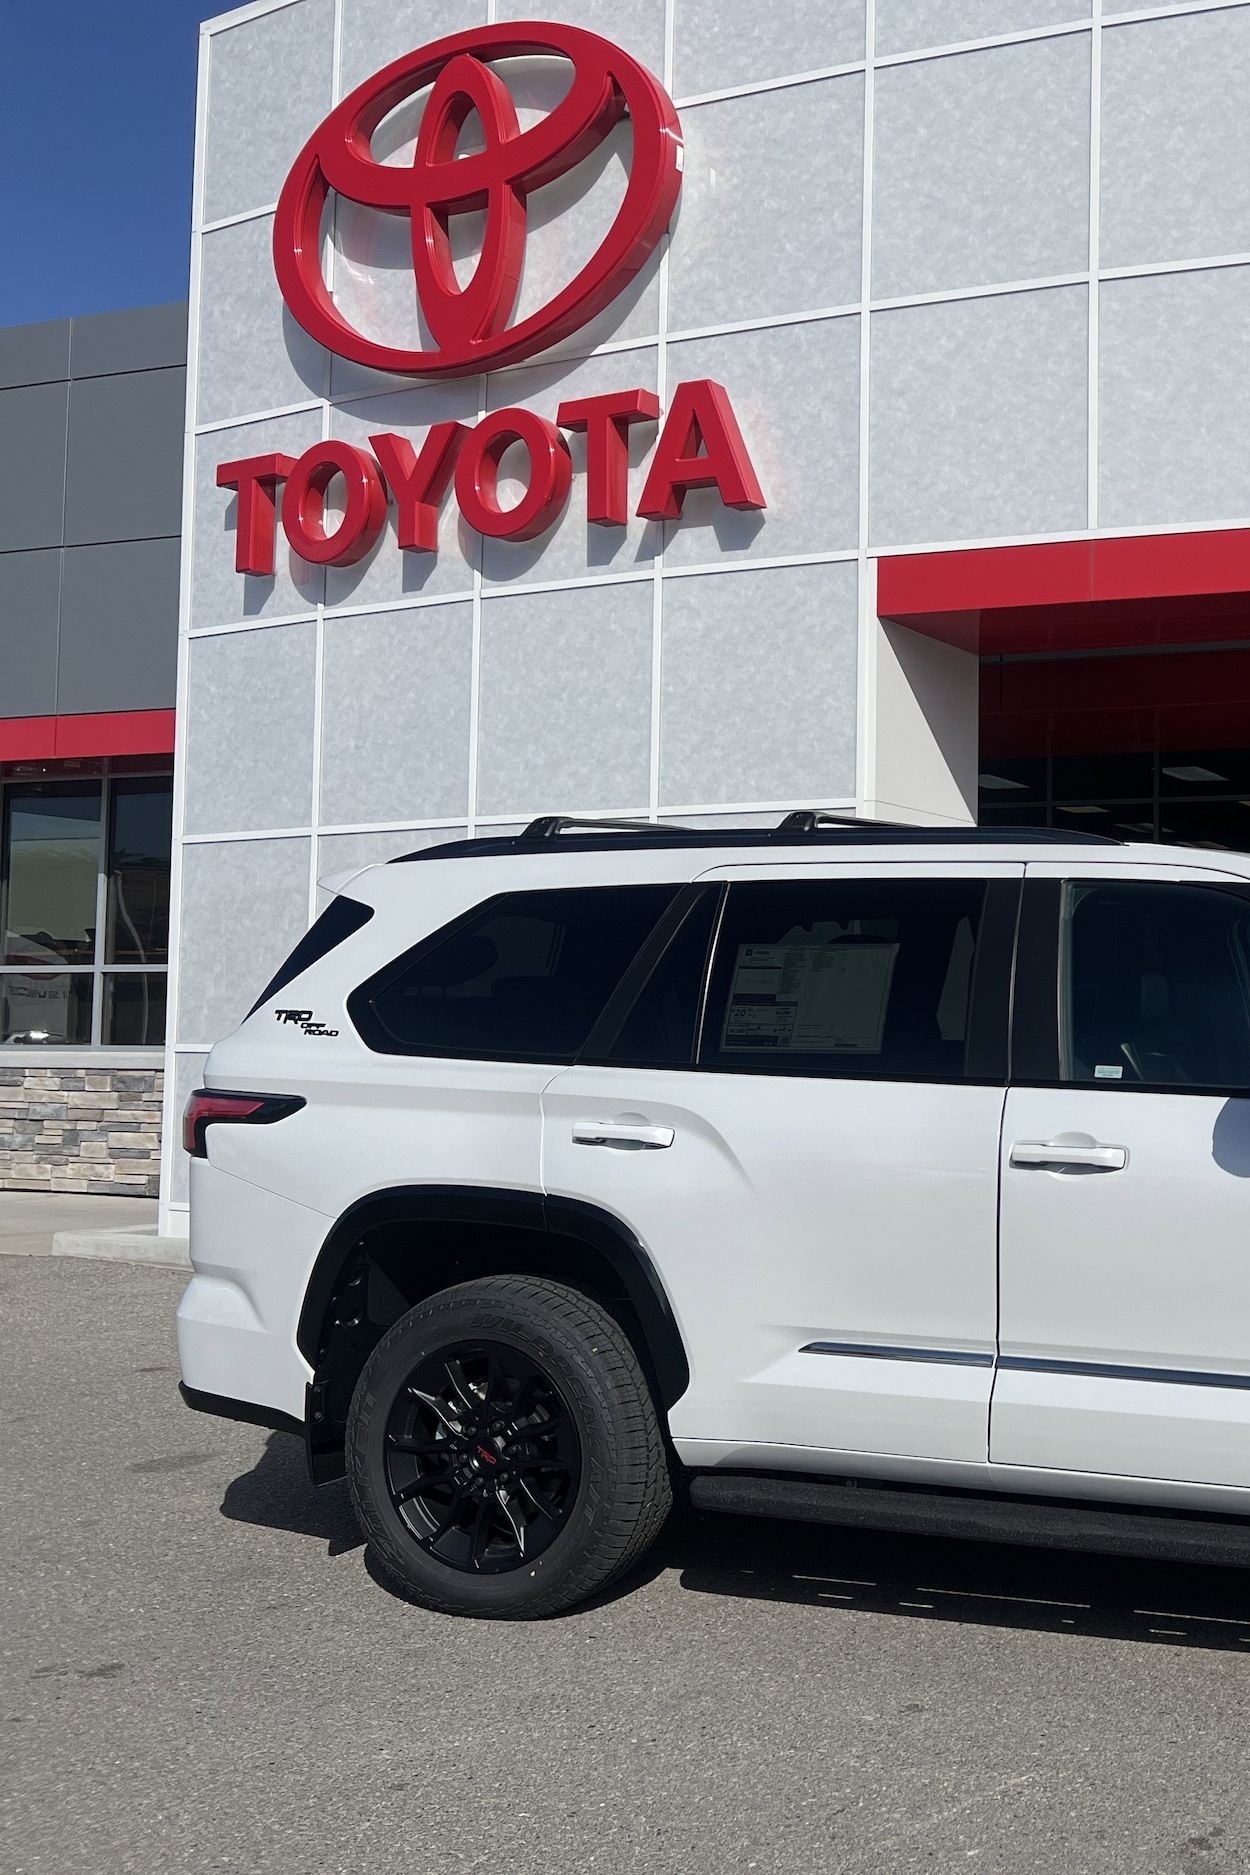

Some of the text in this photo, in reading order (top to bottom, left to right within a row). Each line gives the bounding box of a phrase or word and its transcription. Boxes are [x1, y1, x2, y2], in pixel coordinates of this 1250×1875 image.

[216, 379, 767, 577] TOYOTA
[275, 1009, 313, 1024] TRD
[304, 1029, 339, 1037] ROAD
[476, 1445, 497, 1465] TRD
